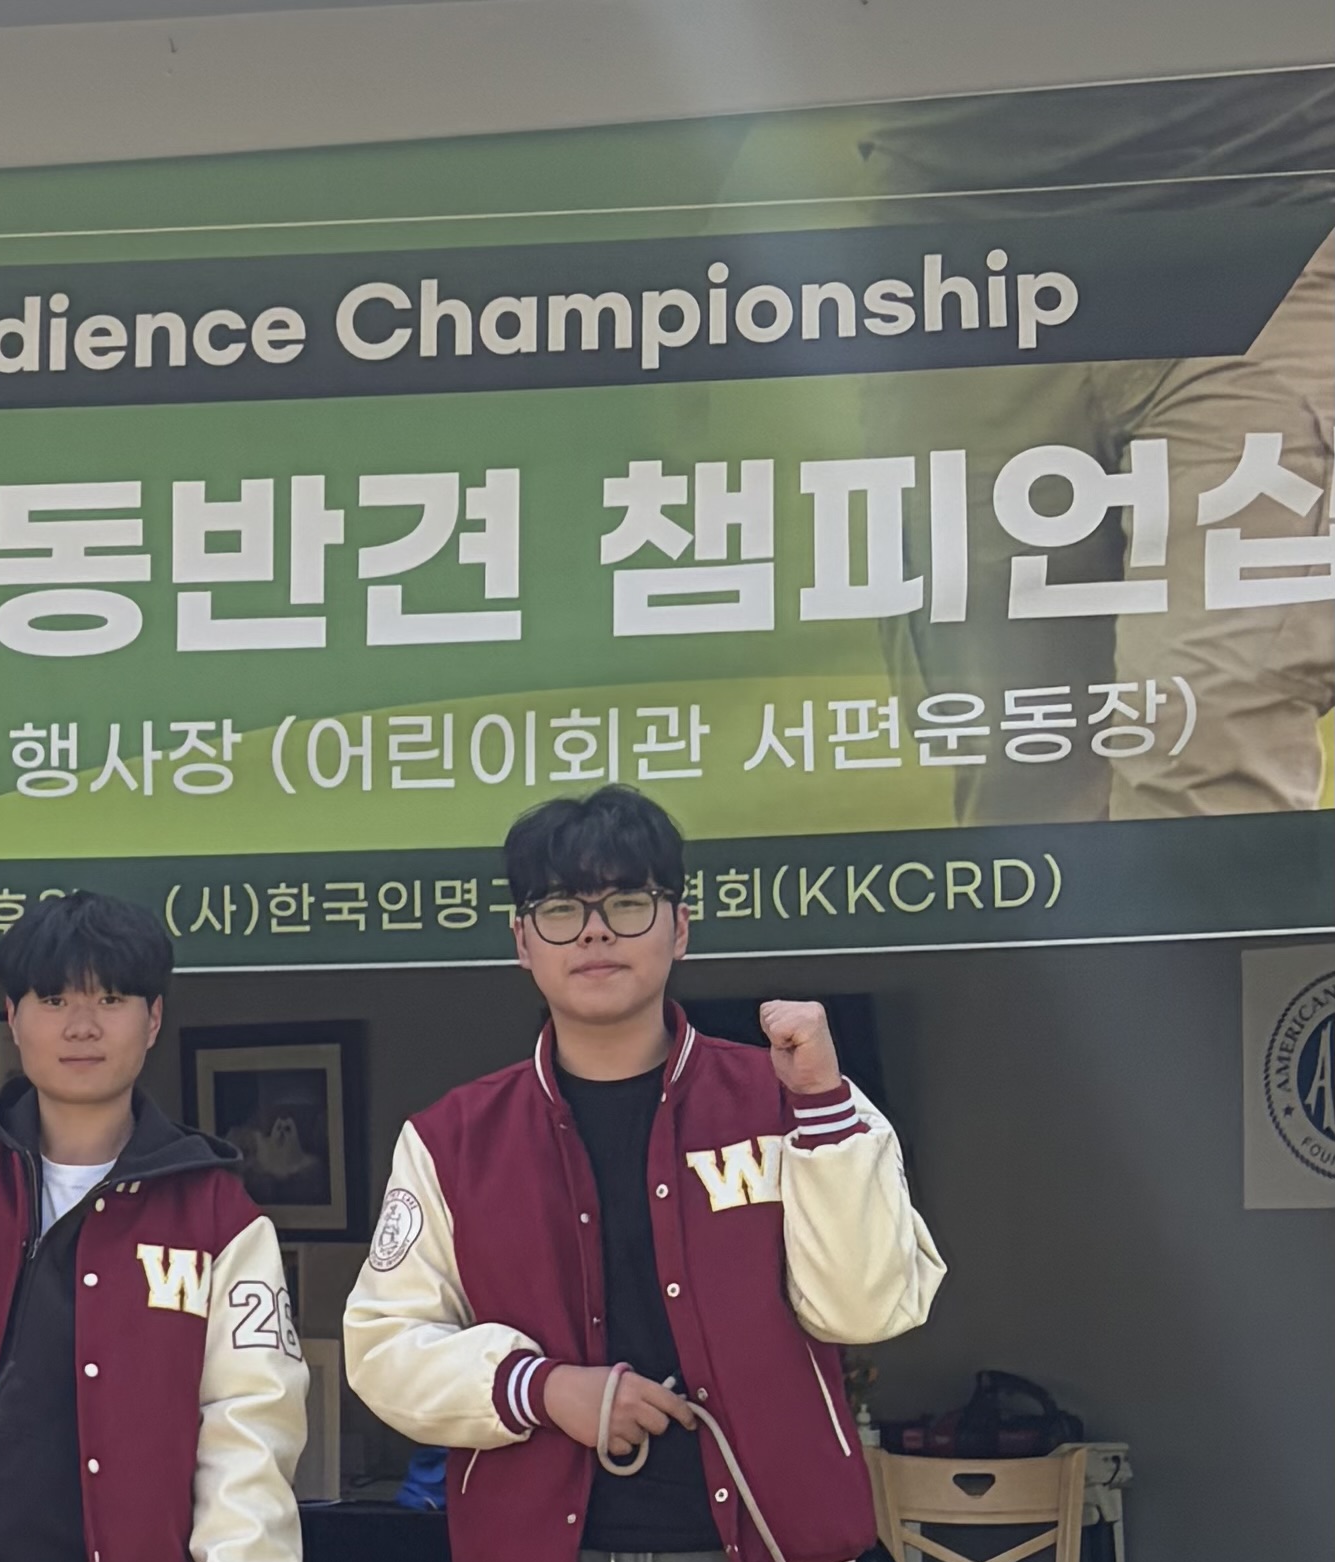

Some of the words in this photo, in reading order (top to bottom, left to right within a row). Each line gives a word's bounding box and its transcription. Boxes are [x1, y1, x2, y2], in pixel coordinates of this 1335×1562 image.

[335, 248, 1080, 372] Championship
[10, 718, 244, 798] 행사장
[270, 702, 712, 800] (어린이회관
[742, 675, 1200, 775] 서편운동장)
[136, 1243, 213, 1319] W
